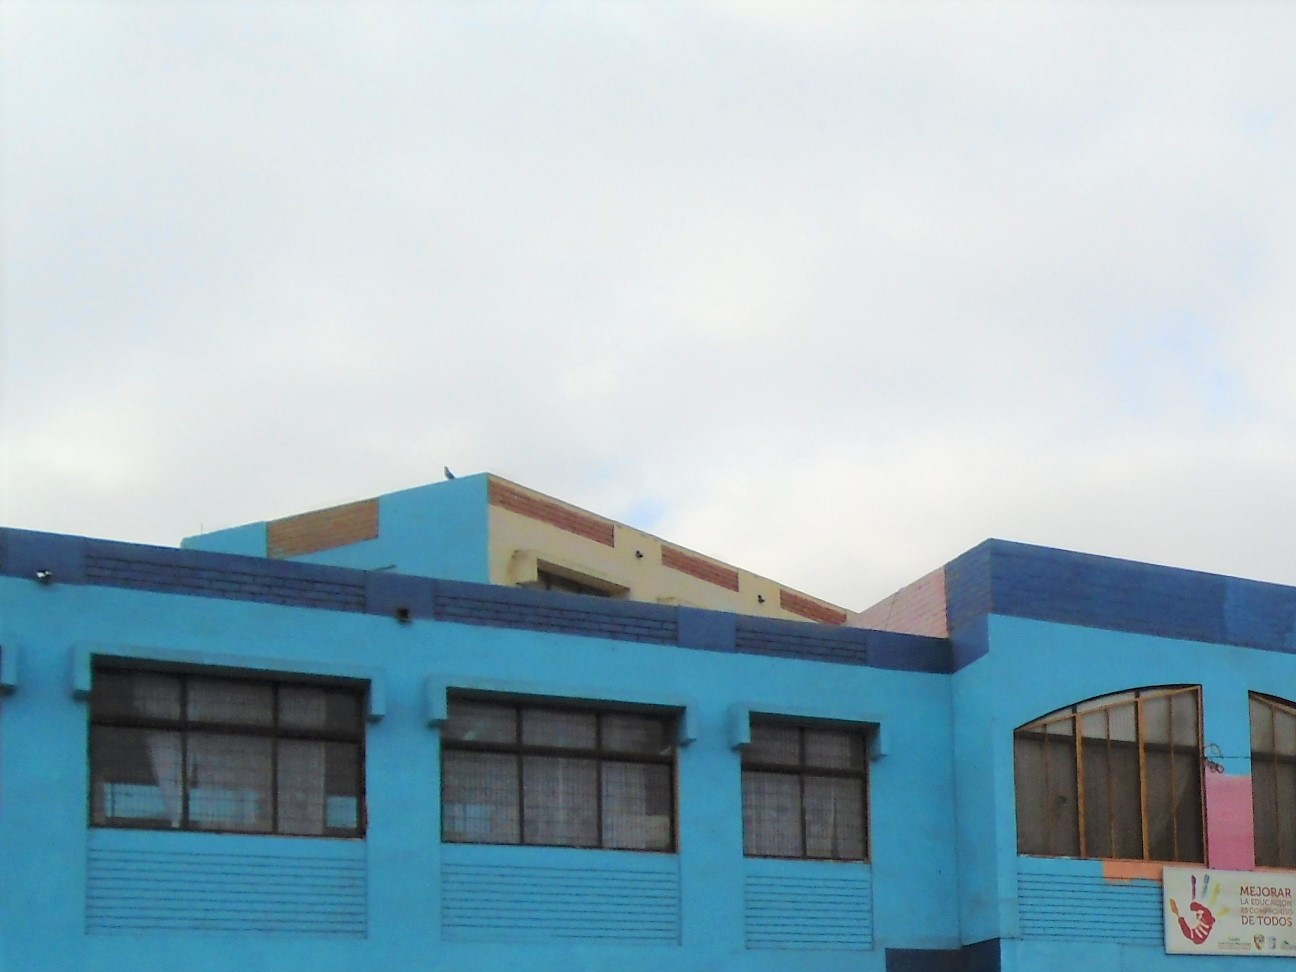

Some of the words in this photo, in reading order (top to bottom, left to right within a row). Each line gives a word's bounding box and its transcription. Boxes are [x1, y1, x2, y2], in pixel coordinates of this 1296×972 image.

[1240, 886, 1291, 898] MEJORAR
[1241, 915, 1254, 925] DE
[1257, 915, 1292, 927] TODOS
